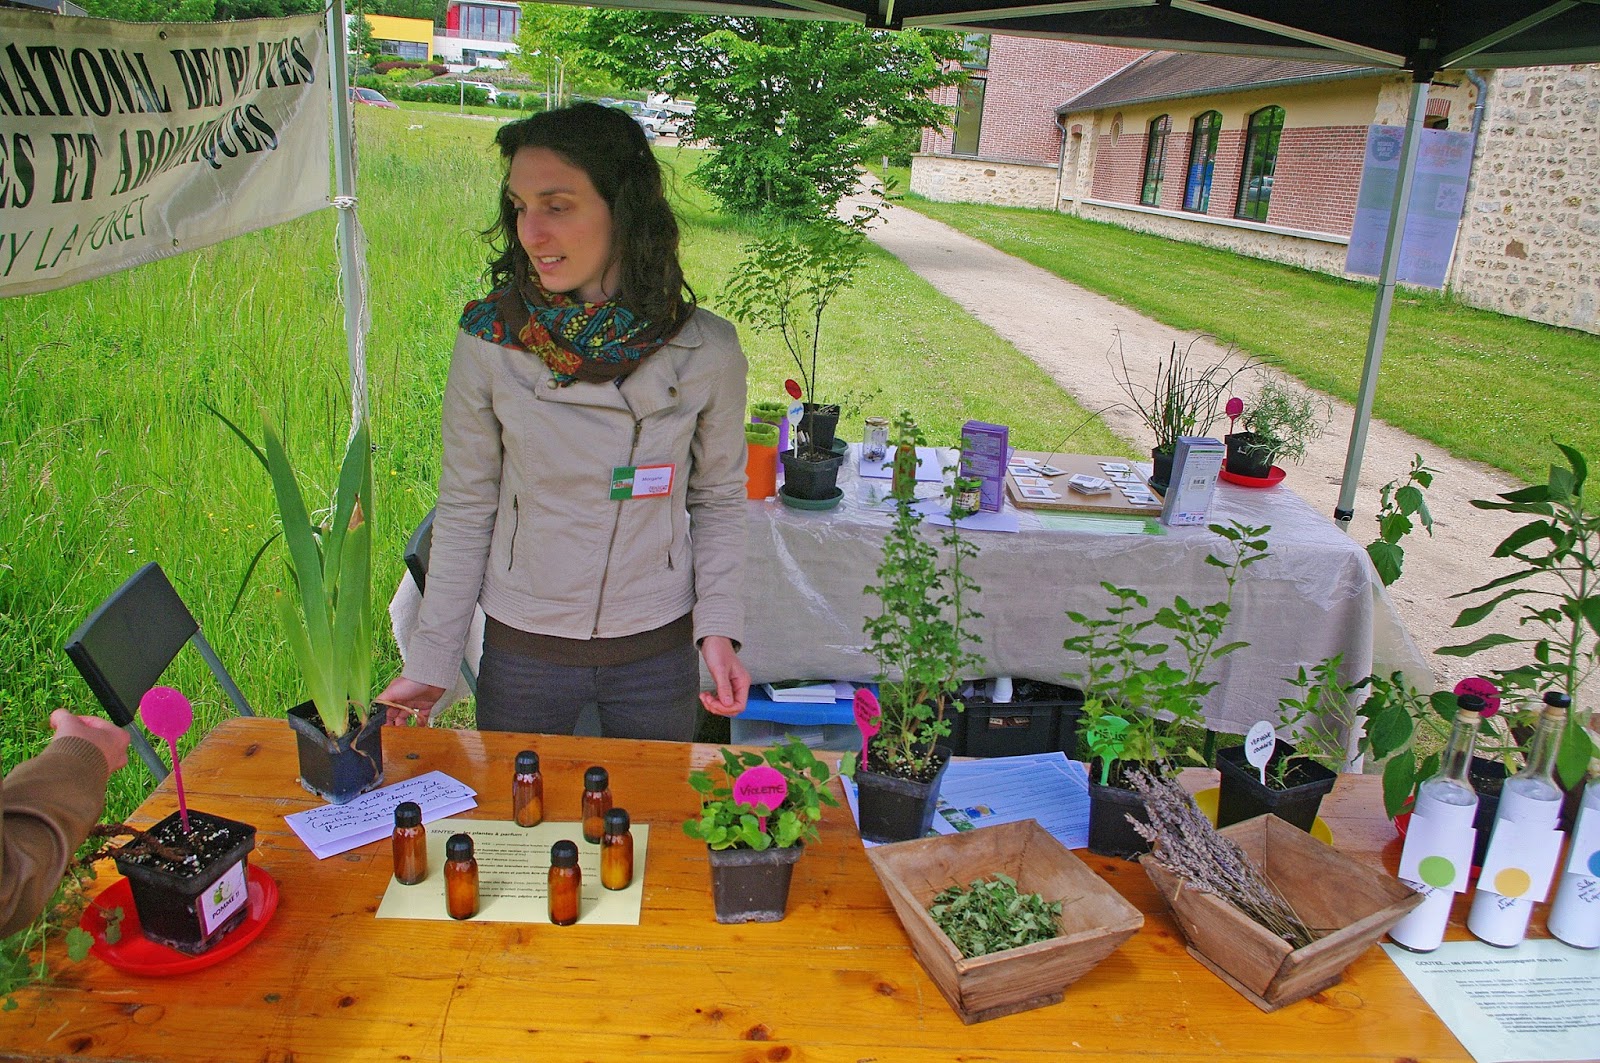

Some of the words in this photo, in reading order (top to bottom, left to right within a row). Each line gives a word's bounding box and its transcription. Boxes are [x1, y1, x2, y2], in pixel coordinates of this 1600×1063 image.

[170, 47, 223, 110] DES
[222, 36, 315, 100] PLNTES
[51, 132, 103, 204] ET
